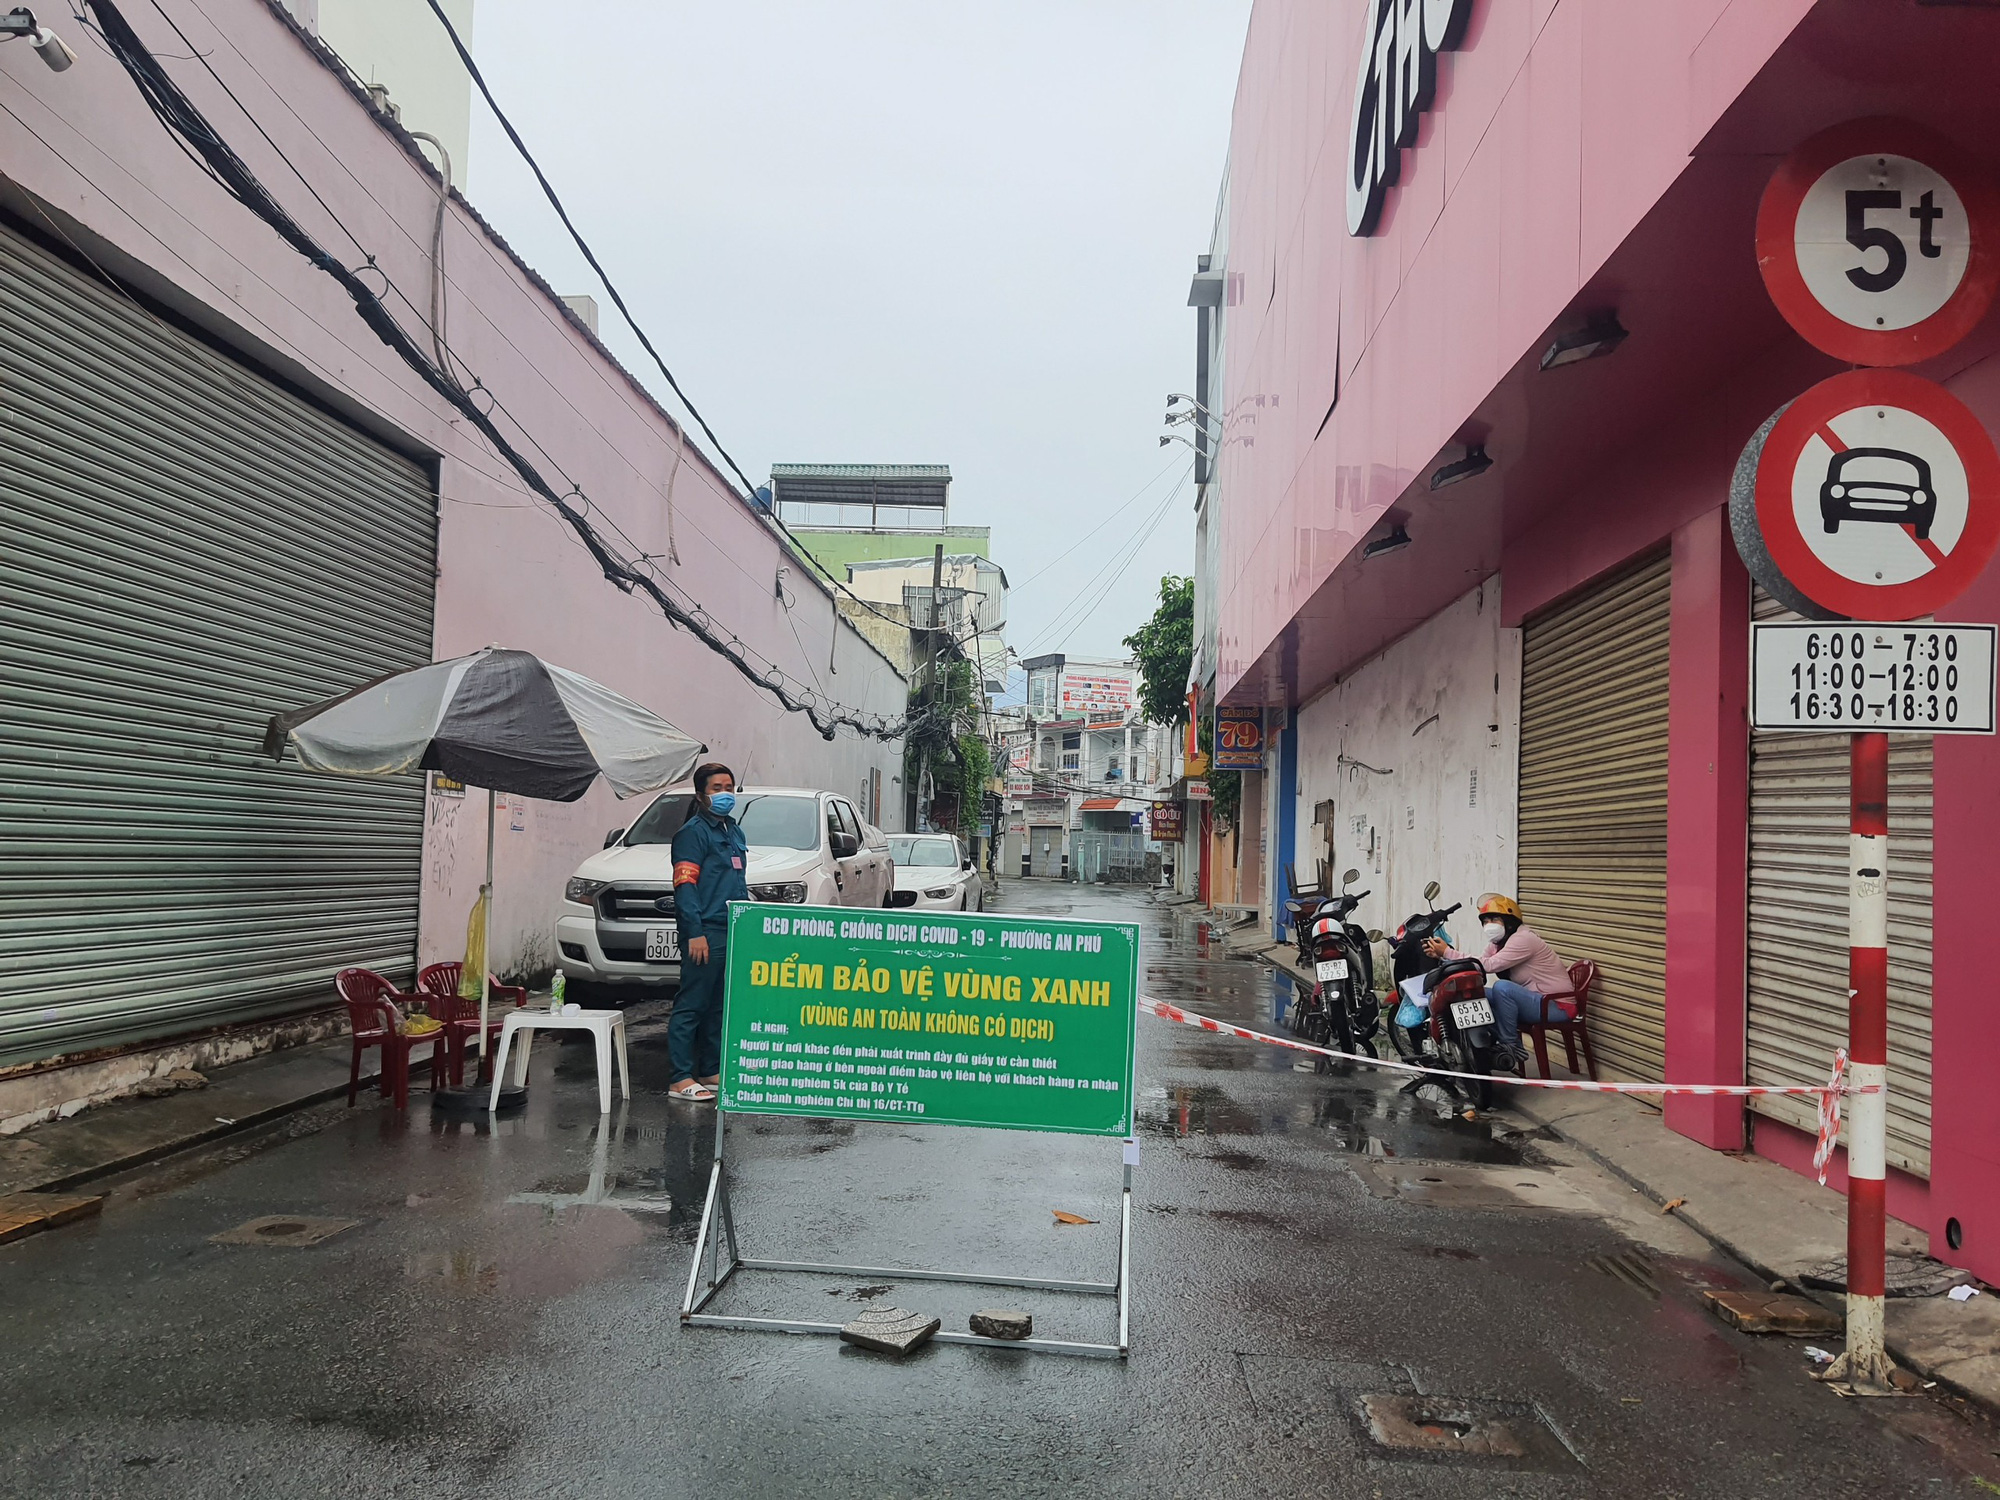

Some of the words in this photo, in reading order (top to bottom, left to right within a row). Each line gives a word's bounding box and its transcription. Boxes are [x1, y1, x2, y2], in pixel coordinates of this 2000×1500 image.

[1845, 189, 1943, 293] 5t
[1807, 633, 1864, 660] 6:00
[1904, 634, 1958, 661] 7:30
[1218, 721, 1259, 749] 79
[1154, 809, 1167, 820] CÔ
[657, 932, 678, 944] 51D
[793, 917, 837, 939] PHÒNG,
[841, 917, 883, 940] CHỐNG
[887, 924, 917, 945] DỊCH
[921, 926, 958, 945] COVID
[971, 929, 985, 946] 19
[1000, 930, 1052, 950] PHƯỜNG
[1055, 934, 1072, 952] AN
[1076, 933, 1102, 953] PHÚ
[648, 945, 679, 958] 090.7
[751, 953, 824, 989] ĐIỂM
[833, 958, 890, 993] BẢO
[900, 965, 934, 1001] VỆ
[944, 968, 1021, 1001] VÙNG
[1031, 977, 1110, 1007] XANH
[765, 1023, 789, 1035] NGHỊ:
[801, 1002, 848, 1027] (VÙNG
[852, 1008, 875, 1028] AN
[880, 1007, 920, 1032] TOÀN
[926, 1010, 980, 1036] KHÔNG
[985, 1013, 1006, 1037] CÓ
[1011, 1018, 1055, 1043] DỊCH)
[740, 1039, 770, 1051] Người
[773, 1041, 784, 1052] từ
[786, 1043, 802, 1053] nơi
[805, 1043, 830, 1055] khác
[833, 1044, 852, 1056] đến
[855, 1046, 878, 1058] phải
[881, 1047, 903, 1059] xuất
[906, 1050, 931, 1061] trình
[934, 1050, 952, 1064] đầy
[956, 1052, 968, 1064] đủ
[972, 1053, 994, 1066] giấy
[997, 1056, 1007, 1066] tờ
[1010, 1055, 1029, 1068] cần
[1032, 1057, 1057, 1069] thiết
[738, 1073, 763, 1087] Thực
[766, 1075, 789, 1088] hiện
[792, 1077, 831, 1089] nghiêm
[849, 1080, 868, 1092] của
[871, 1081, 885, 1094] Bộ
[888, 1083, 894, 1093] Y
[897, 1082, 909, 1094] Tế
[739, 1056, 769, 1069] Người
[772, 1059, 794, 1070] giao
[797, 1060, 823, 1073] hàng
[835, 1062, 855, 1073] bên
[857, 1064, 887, 1076] ngoài
[889, 1065, 916, 1078] điểm
[918, 1067, 938, 1079] bảo
[941, 1069, 953, 1082] vệ
[956, 1070, 976, 1082] liên
[979, 1071, 992, 1085] hệ
[995, 1073, 1011, 1084] với
[1013, 1074, 1045, 1086] khách
[1048, 1076, 1075, 1089] hàng
[1078, 1079, 1089, 1089] ra
[1092, 1079, 1119, 1092] nhận
[737, 1090, 763, 1103] Chấp
[766, 1092, 792, 1104] hành
[795, 1094, 834, 1107] nghiêm
[857, 1098, 871, 1110] thị
[874, 1099, 925, 1114] 16/CT-TTg
